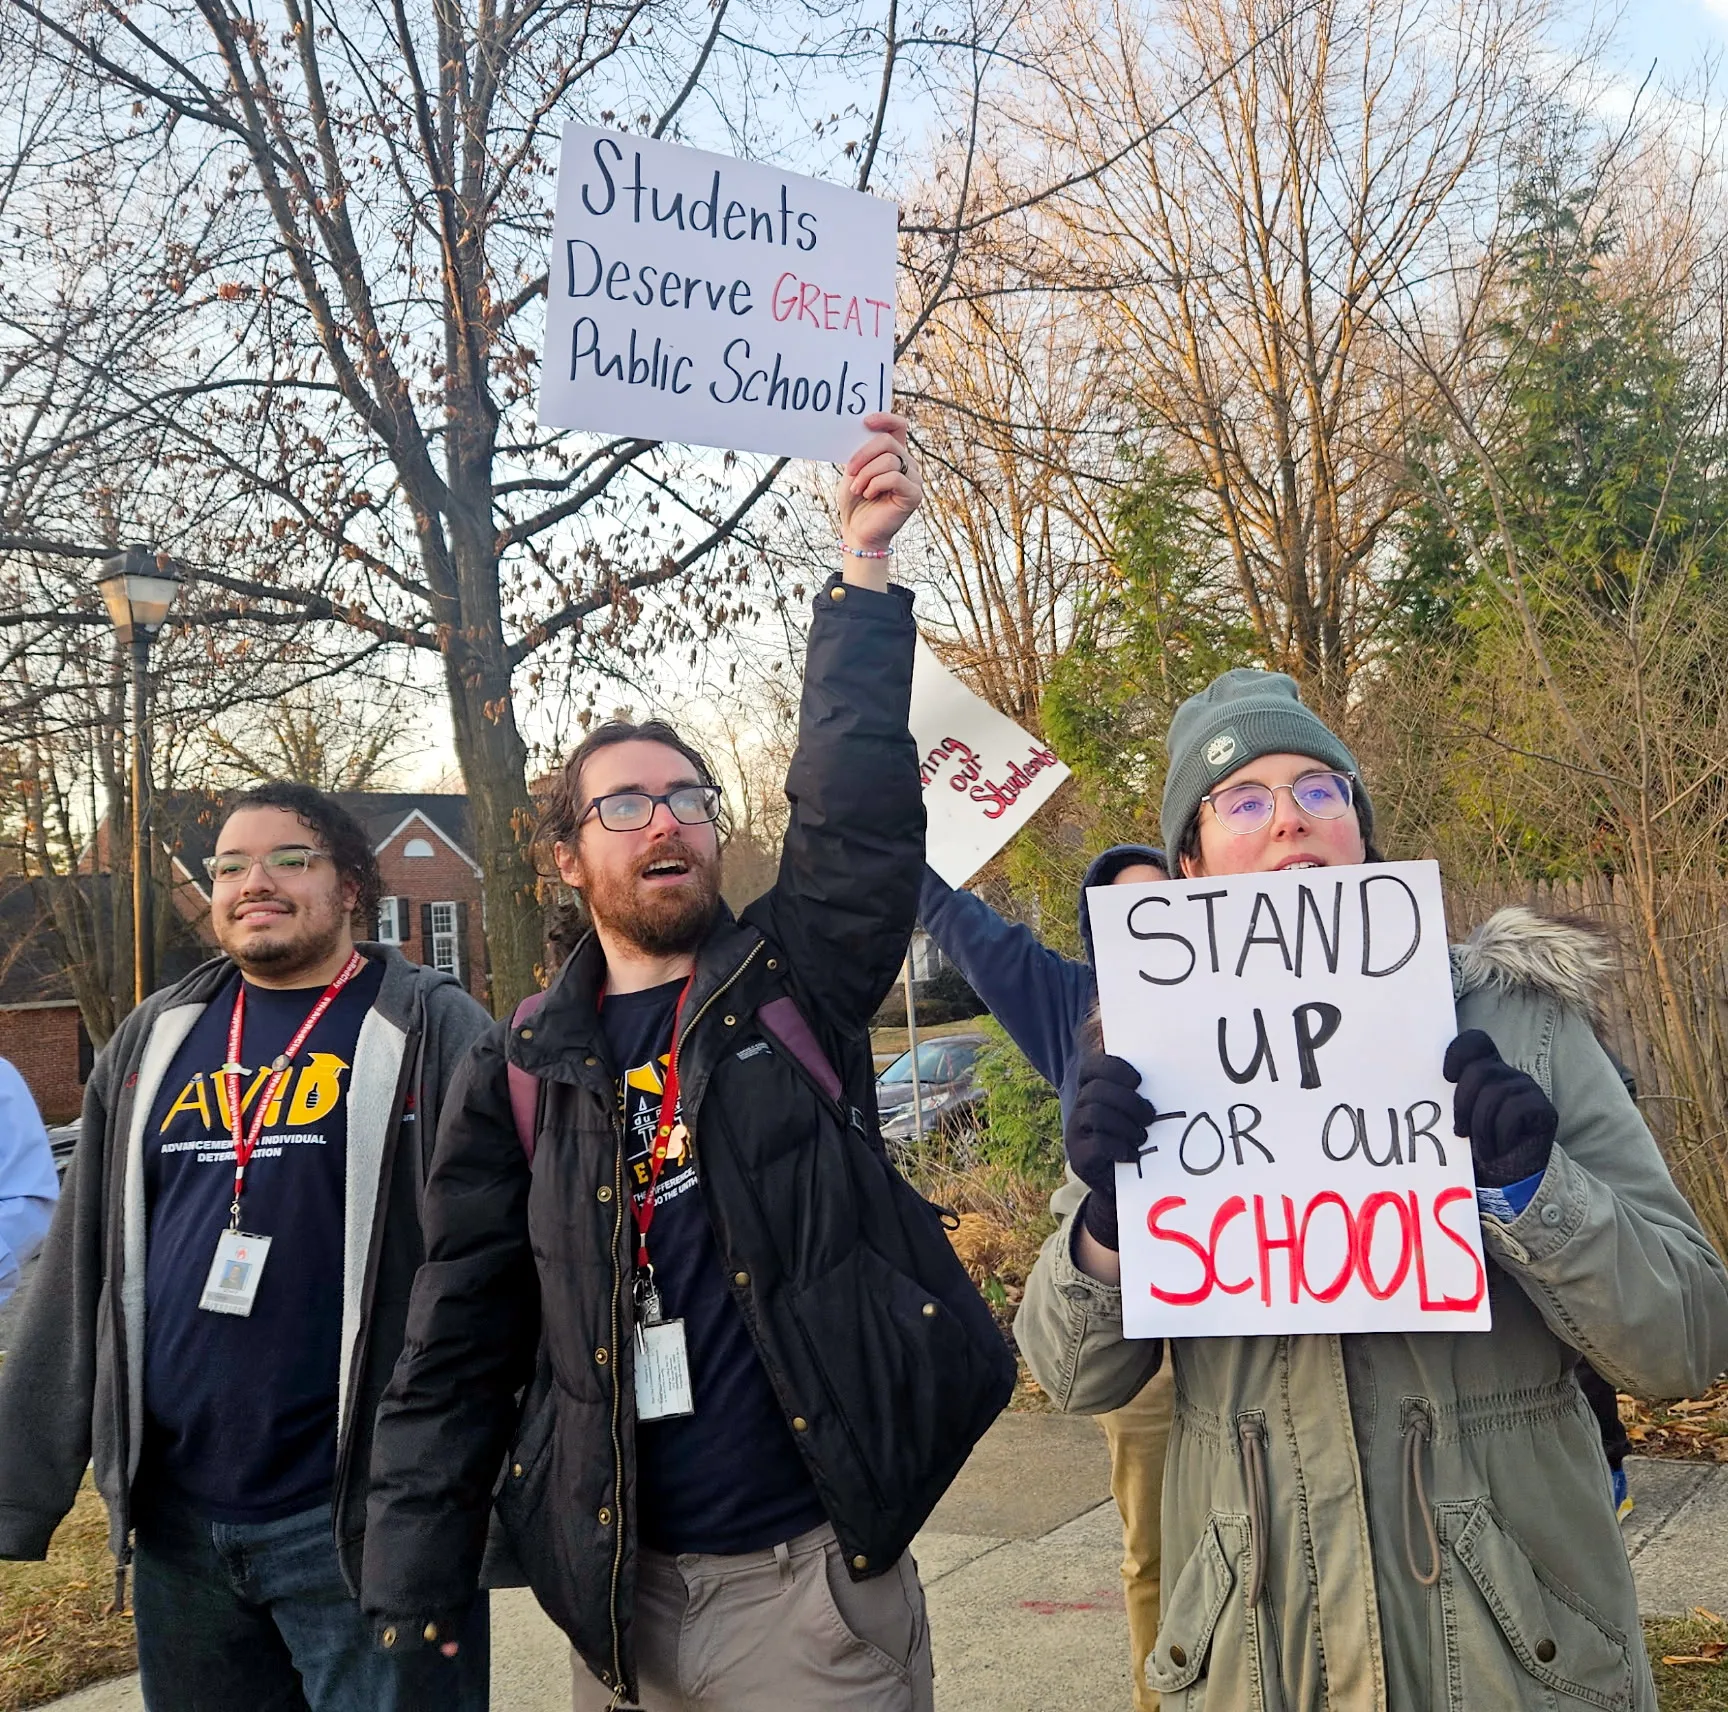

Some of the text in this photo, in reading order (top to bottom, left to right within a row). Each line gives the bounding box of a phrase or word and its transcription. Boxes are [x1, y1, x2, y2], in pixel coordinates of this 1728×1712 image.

[582, 138, 817, 251] Students
[566, 239, 891, 338] Deserve GREAT
[570, 317, 885, 416] Public Schools!
[949, 754, 983, 792] our
[969, 746, 1059, 820] Students
[1126, 874, 1422, 986] STAND
[1217, 1001, 1342, 1089] UP
[261, 1134, 327, 1146] INDIVIDUAL
[1321, 1100, 1447, 1167] OUR
[1147, 1186, 1486, 1314] SCHOOLS
